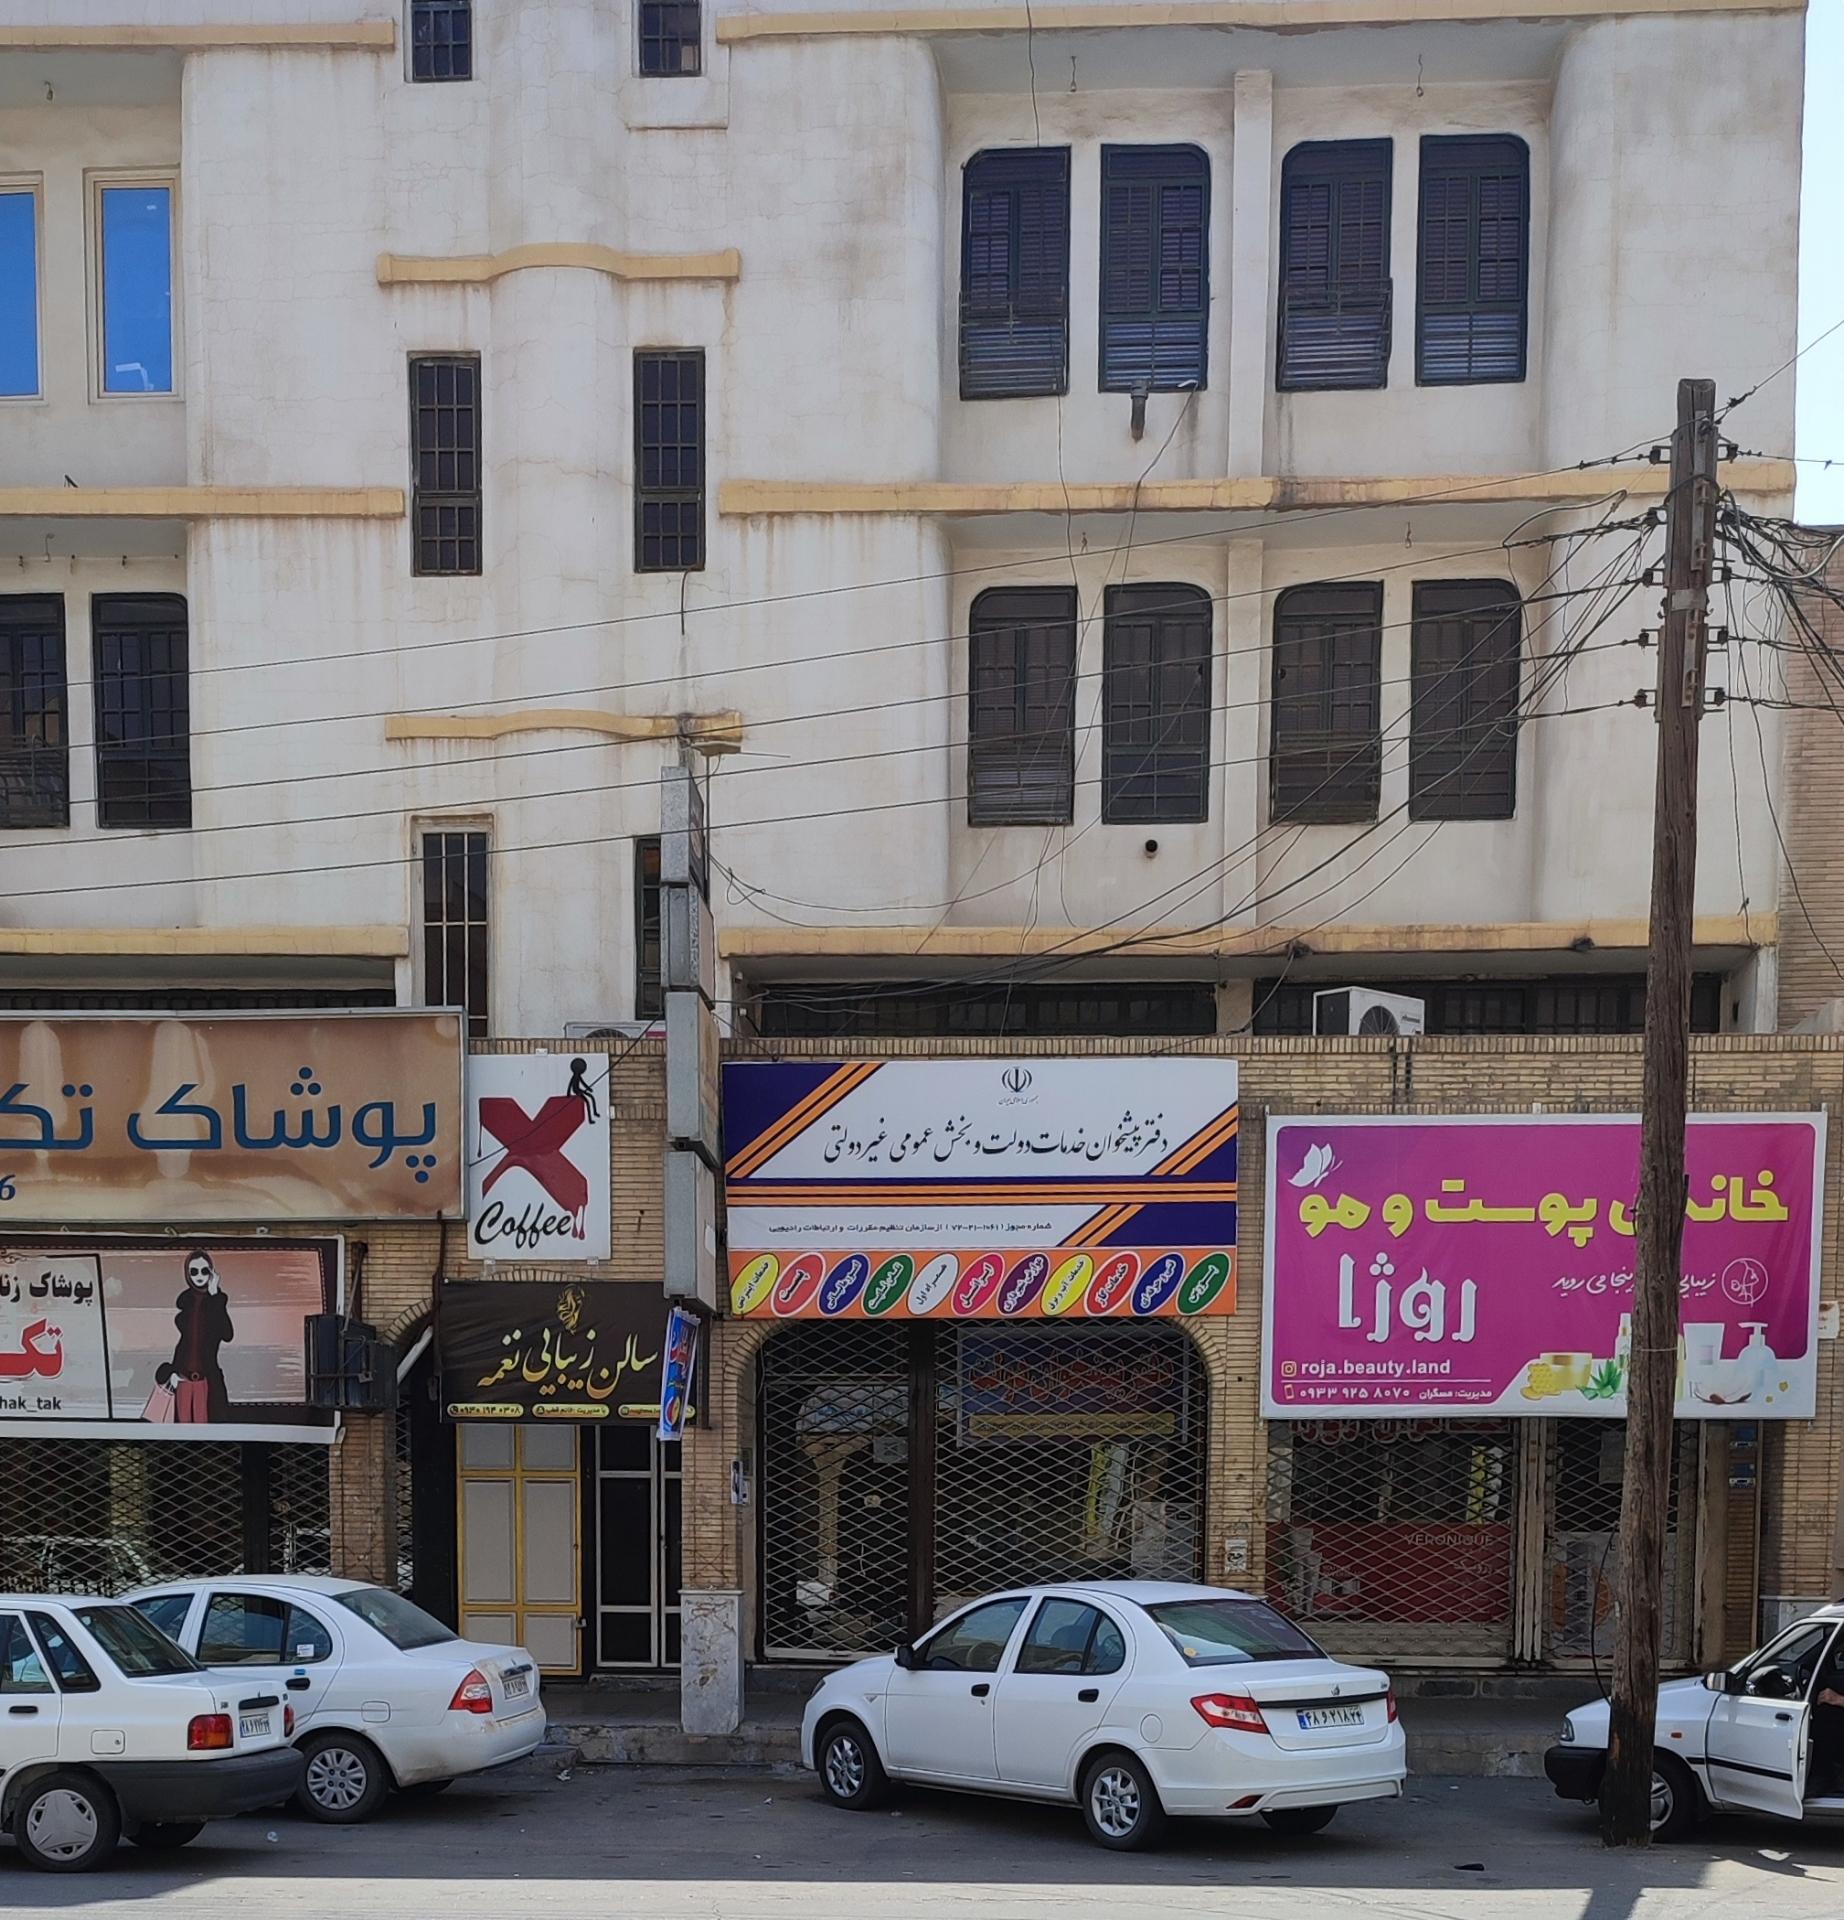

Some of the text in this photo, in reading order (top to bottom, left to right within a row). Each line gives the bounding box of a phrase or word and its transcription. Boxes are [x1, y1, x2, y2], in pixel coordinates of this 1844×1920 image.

[127, 1066, 437, 1184] پوشاک
[889, 1126, 934, 1163] عمومی
[934, 1115, 974, 1162] بخش
[1031, 1127, 1086, 1154] خدمات
[1086, 1109, 1141, 1161] پیشخوان
[1134, 1112, 1169, 1158] دفتر
[475, 1201, 570, 1249] Coffee
[1382, 1193, 1414, 1238] و
[1425, 1179, 1598, 1248] پوست
[29, 1271, 93, 1306] پوشاک
[1338, 1252, 1479, 1343] روژا
[522, 1327, 597, 1396] زیبایی
[586, 1334, 658, 1399] سالن
[1301, 1359, 1451, 1378] roja.beauty.land
